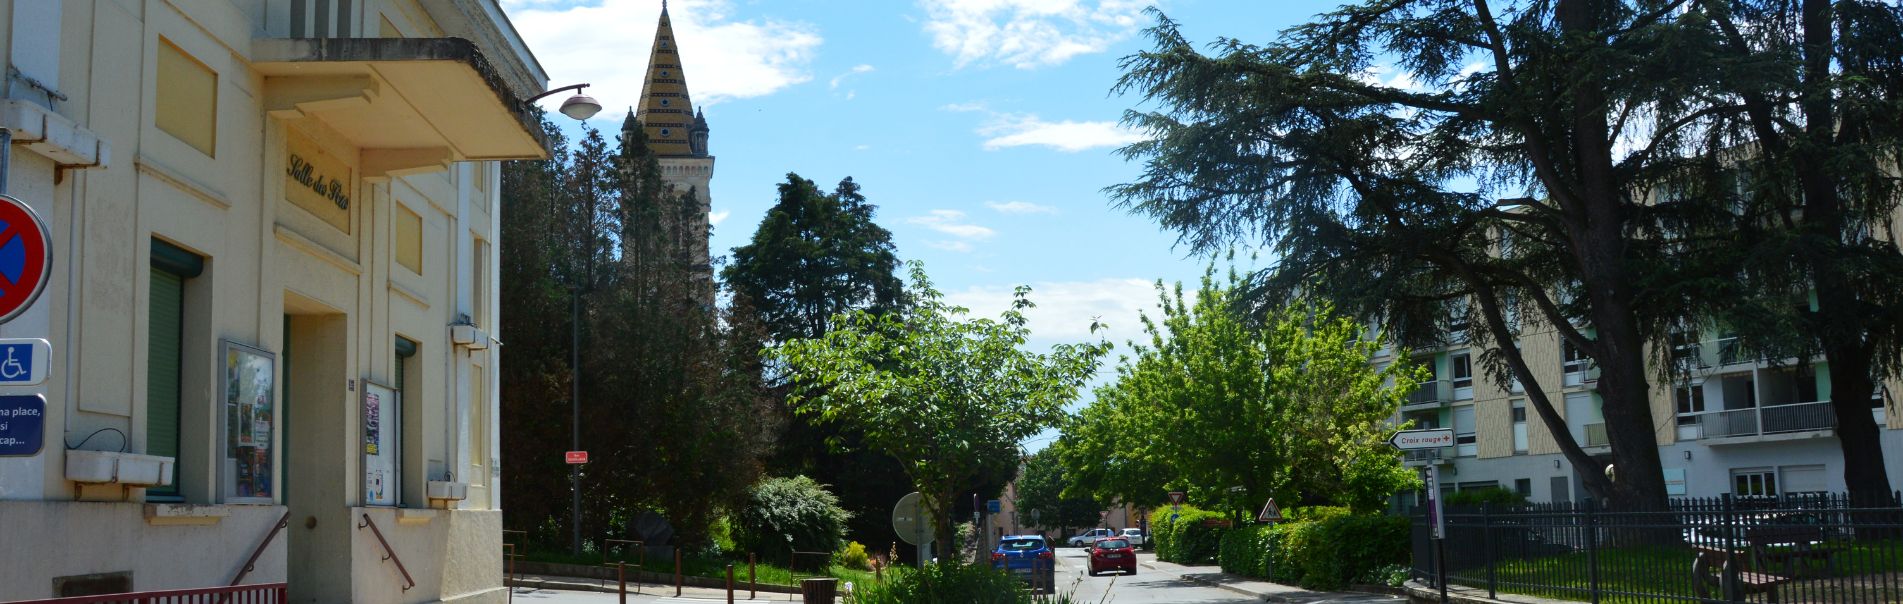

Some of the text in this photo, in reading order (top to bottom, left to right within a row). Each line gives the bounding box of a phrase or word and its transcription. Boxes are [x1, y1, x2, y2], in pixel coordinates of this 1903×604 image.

[287, 154, 313, 188] Salle
[12, 407, 41, 418] place,
[1401, 436, 1419, 444] Croix
